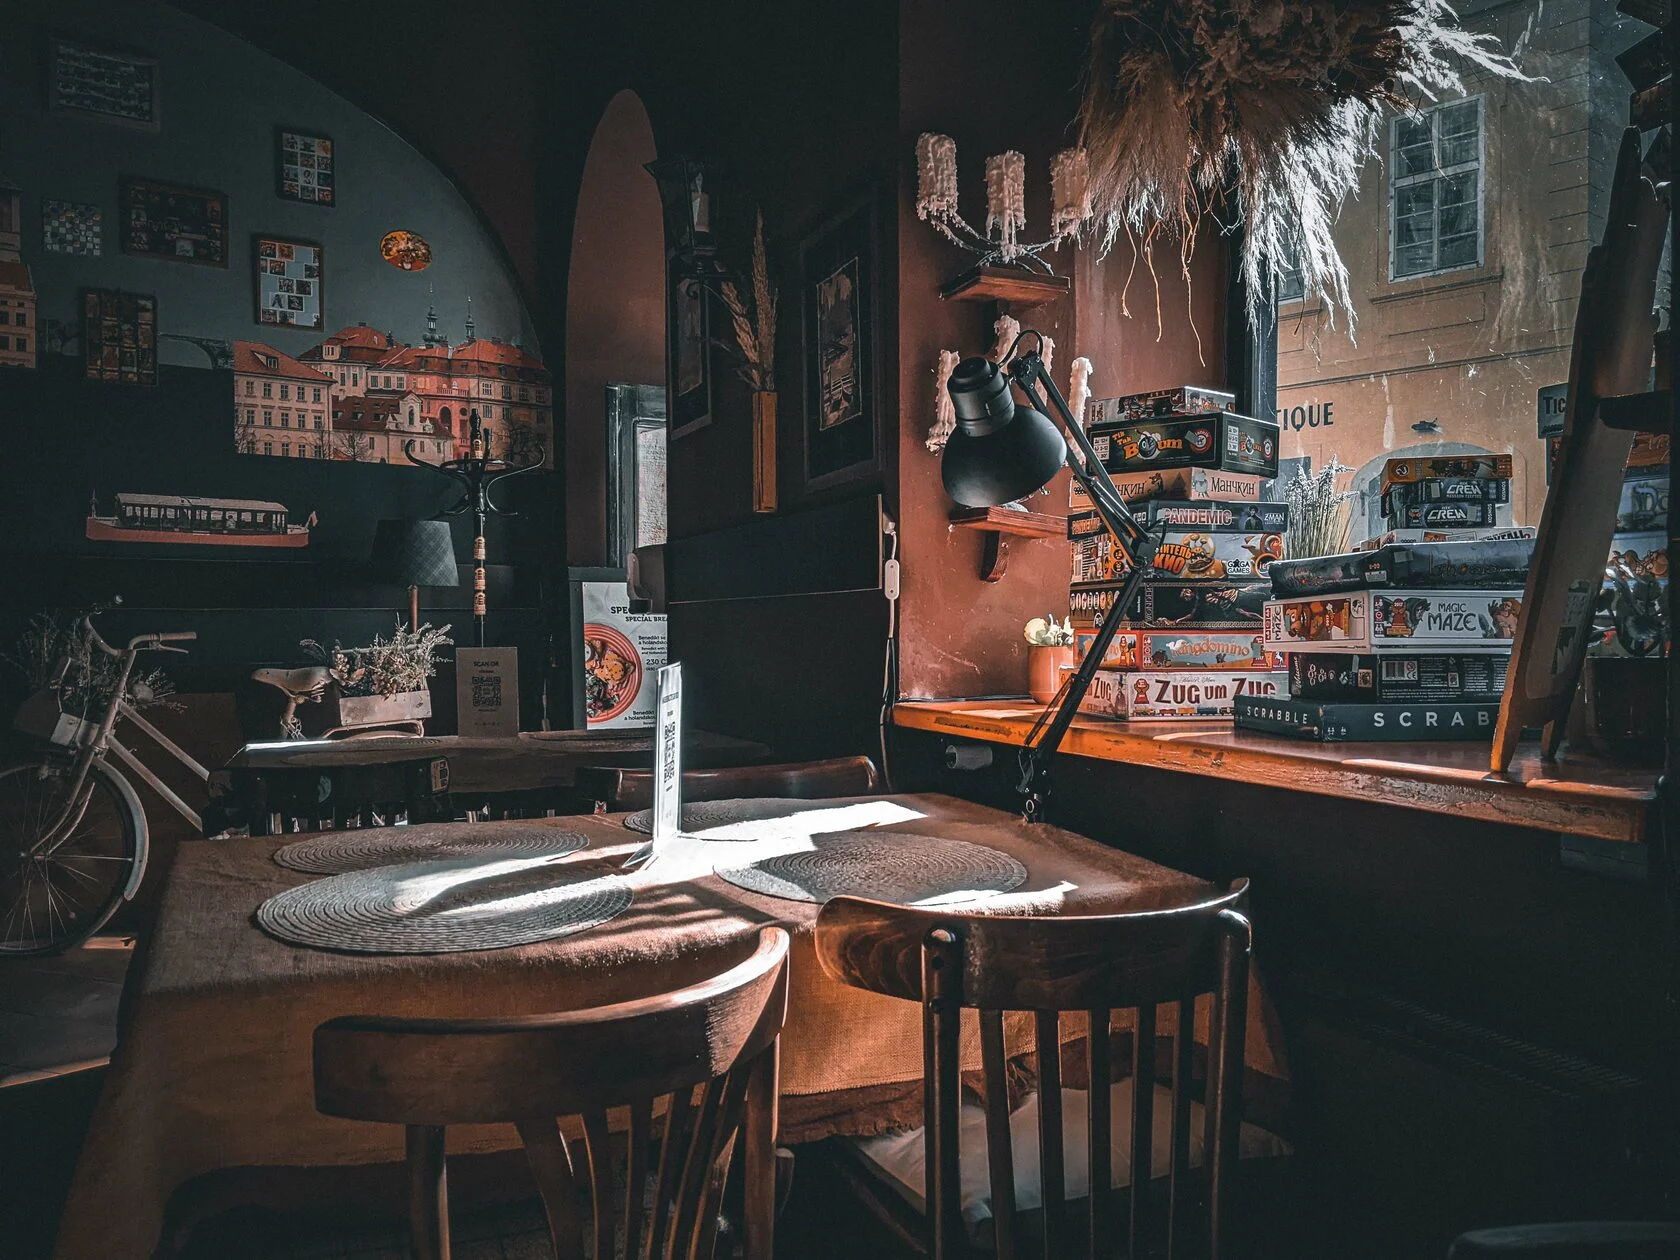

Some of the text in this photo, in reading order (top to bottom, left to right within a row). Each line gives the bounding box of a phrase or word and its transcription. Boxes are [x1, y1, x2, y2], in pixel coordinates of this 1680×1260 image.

[1543, 396, 1566, 415] TIC
[1211, 478, 1255, 495] Манчкин
[1446, 484, 1482, 495] CREW
[1163, 508, 1233, 526] PANDEMIC
[1427, 509, 1467, 520] CREW
[1152, 553, 1186, 574] КИО
[610, 606, 629, 614] SPE
[1438, 603, 1467, 613] MAGIC
[1428, 612, 1477, 631] MAZE
[1247, 705, 1308, 724] SCRABBLE
[1373, 711, 1490, 727] SCRAB
